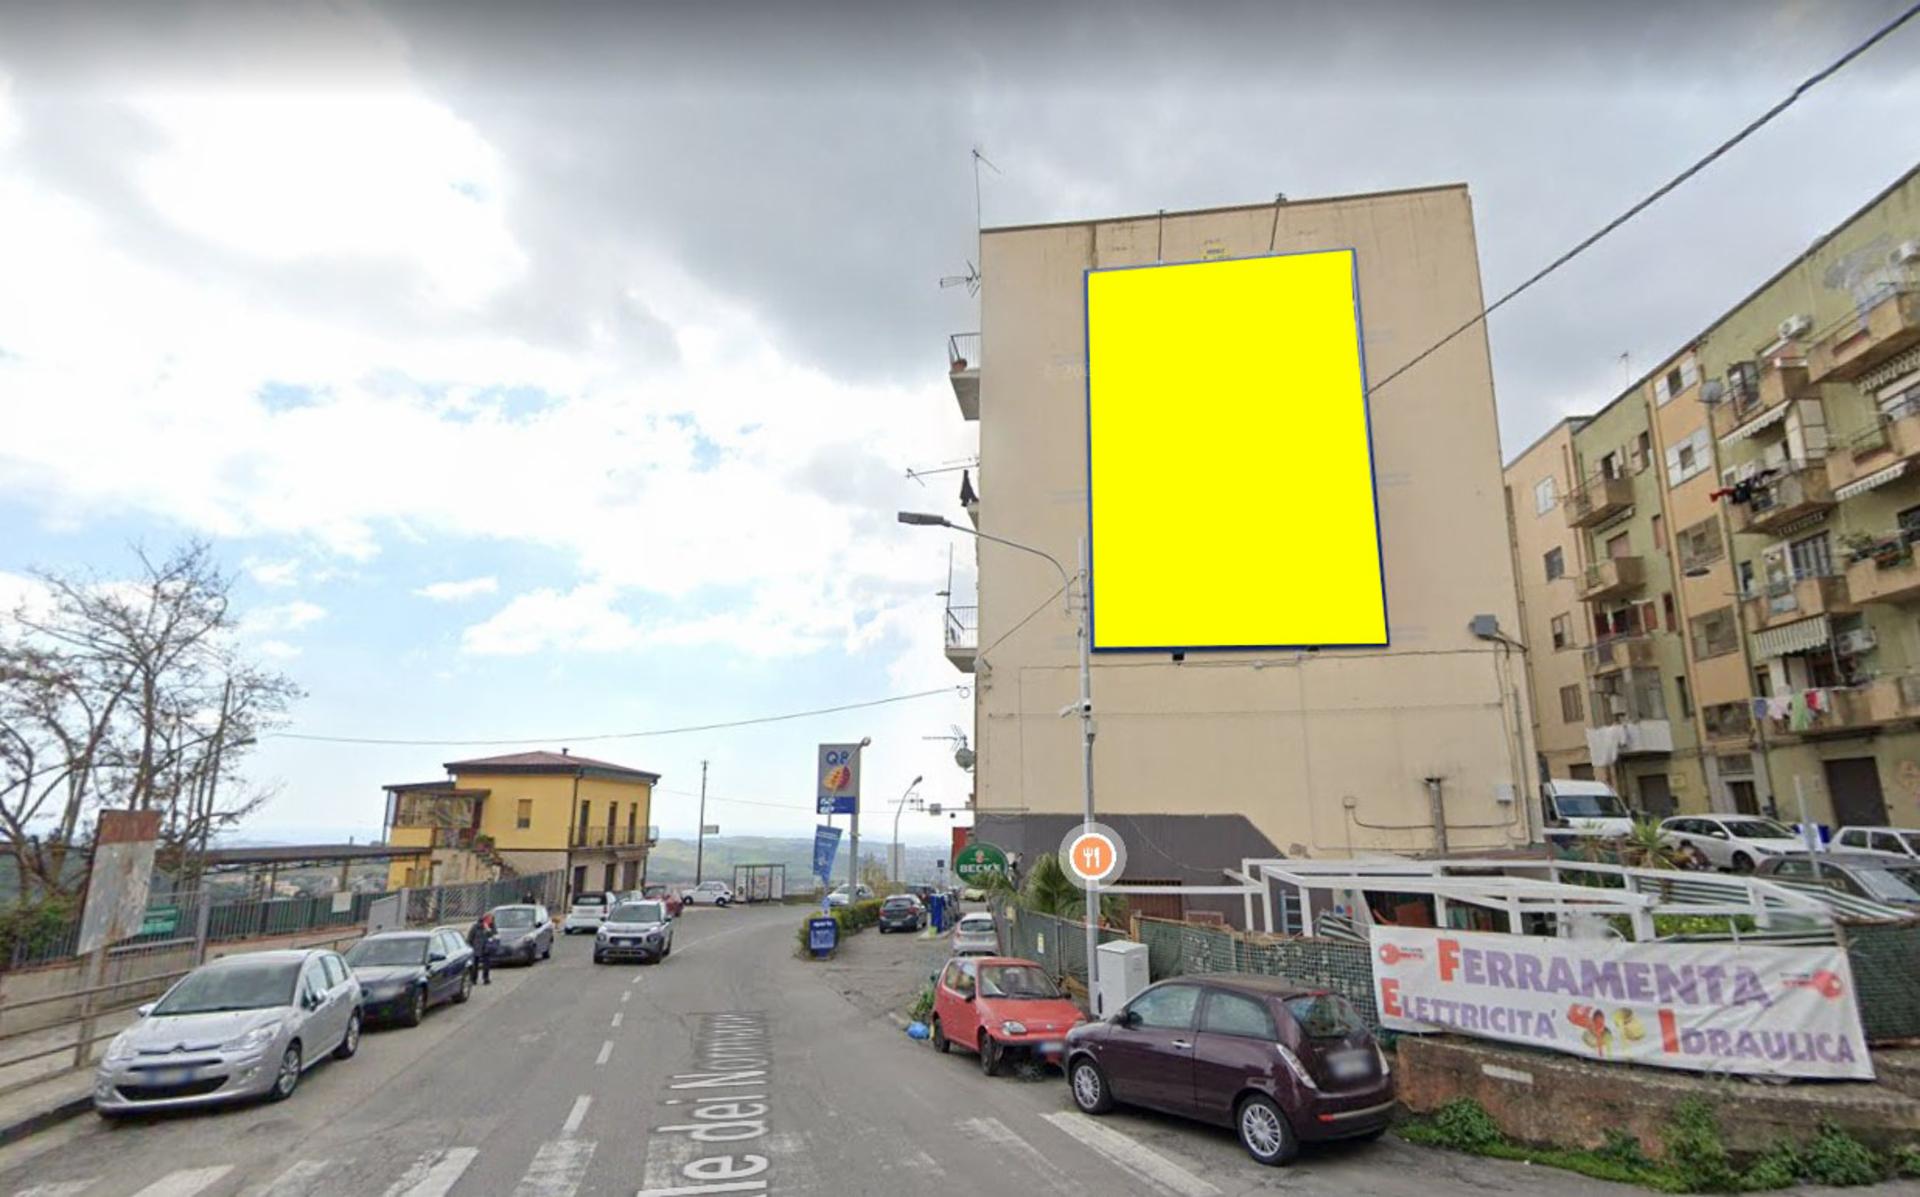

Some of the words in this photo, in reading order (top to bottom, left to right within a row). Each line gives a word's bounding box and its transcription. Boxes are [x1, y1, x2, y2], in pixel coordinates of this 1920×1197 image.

[826, 751, 850, 765] Q8
[1437, 938, 1770, 1009] FERRAMENTA
[1658, 1009, 1855, 1062] IDRAULICA
